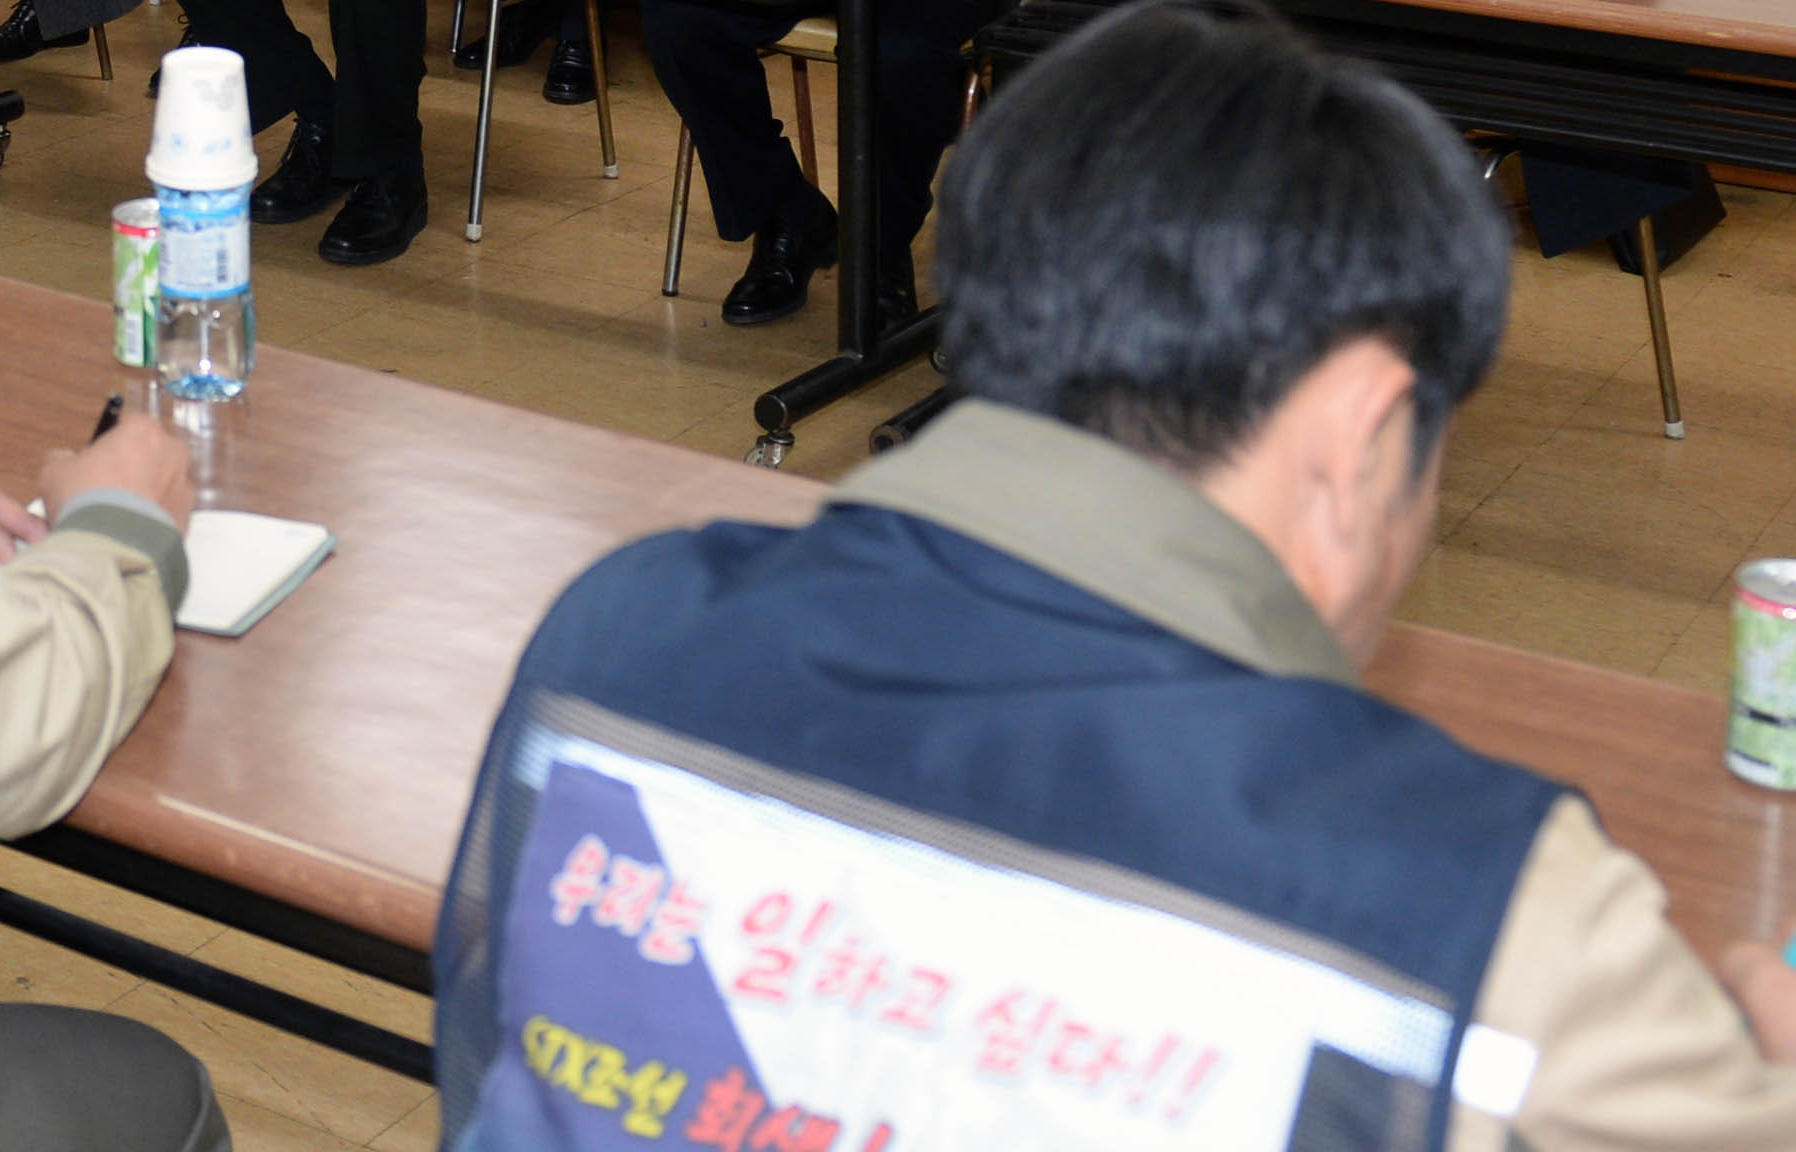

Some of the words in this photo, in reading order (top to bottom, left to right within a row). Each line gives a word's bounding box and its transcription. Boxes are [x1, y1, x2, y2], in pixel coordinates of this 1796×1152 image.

[550, 834, 706, 966] 우리는
[731, 890, 956, 1032] 일하고
[975, 988, 1222, 1120] 싶다!!
